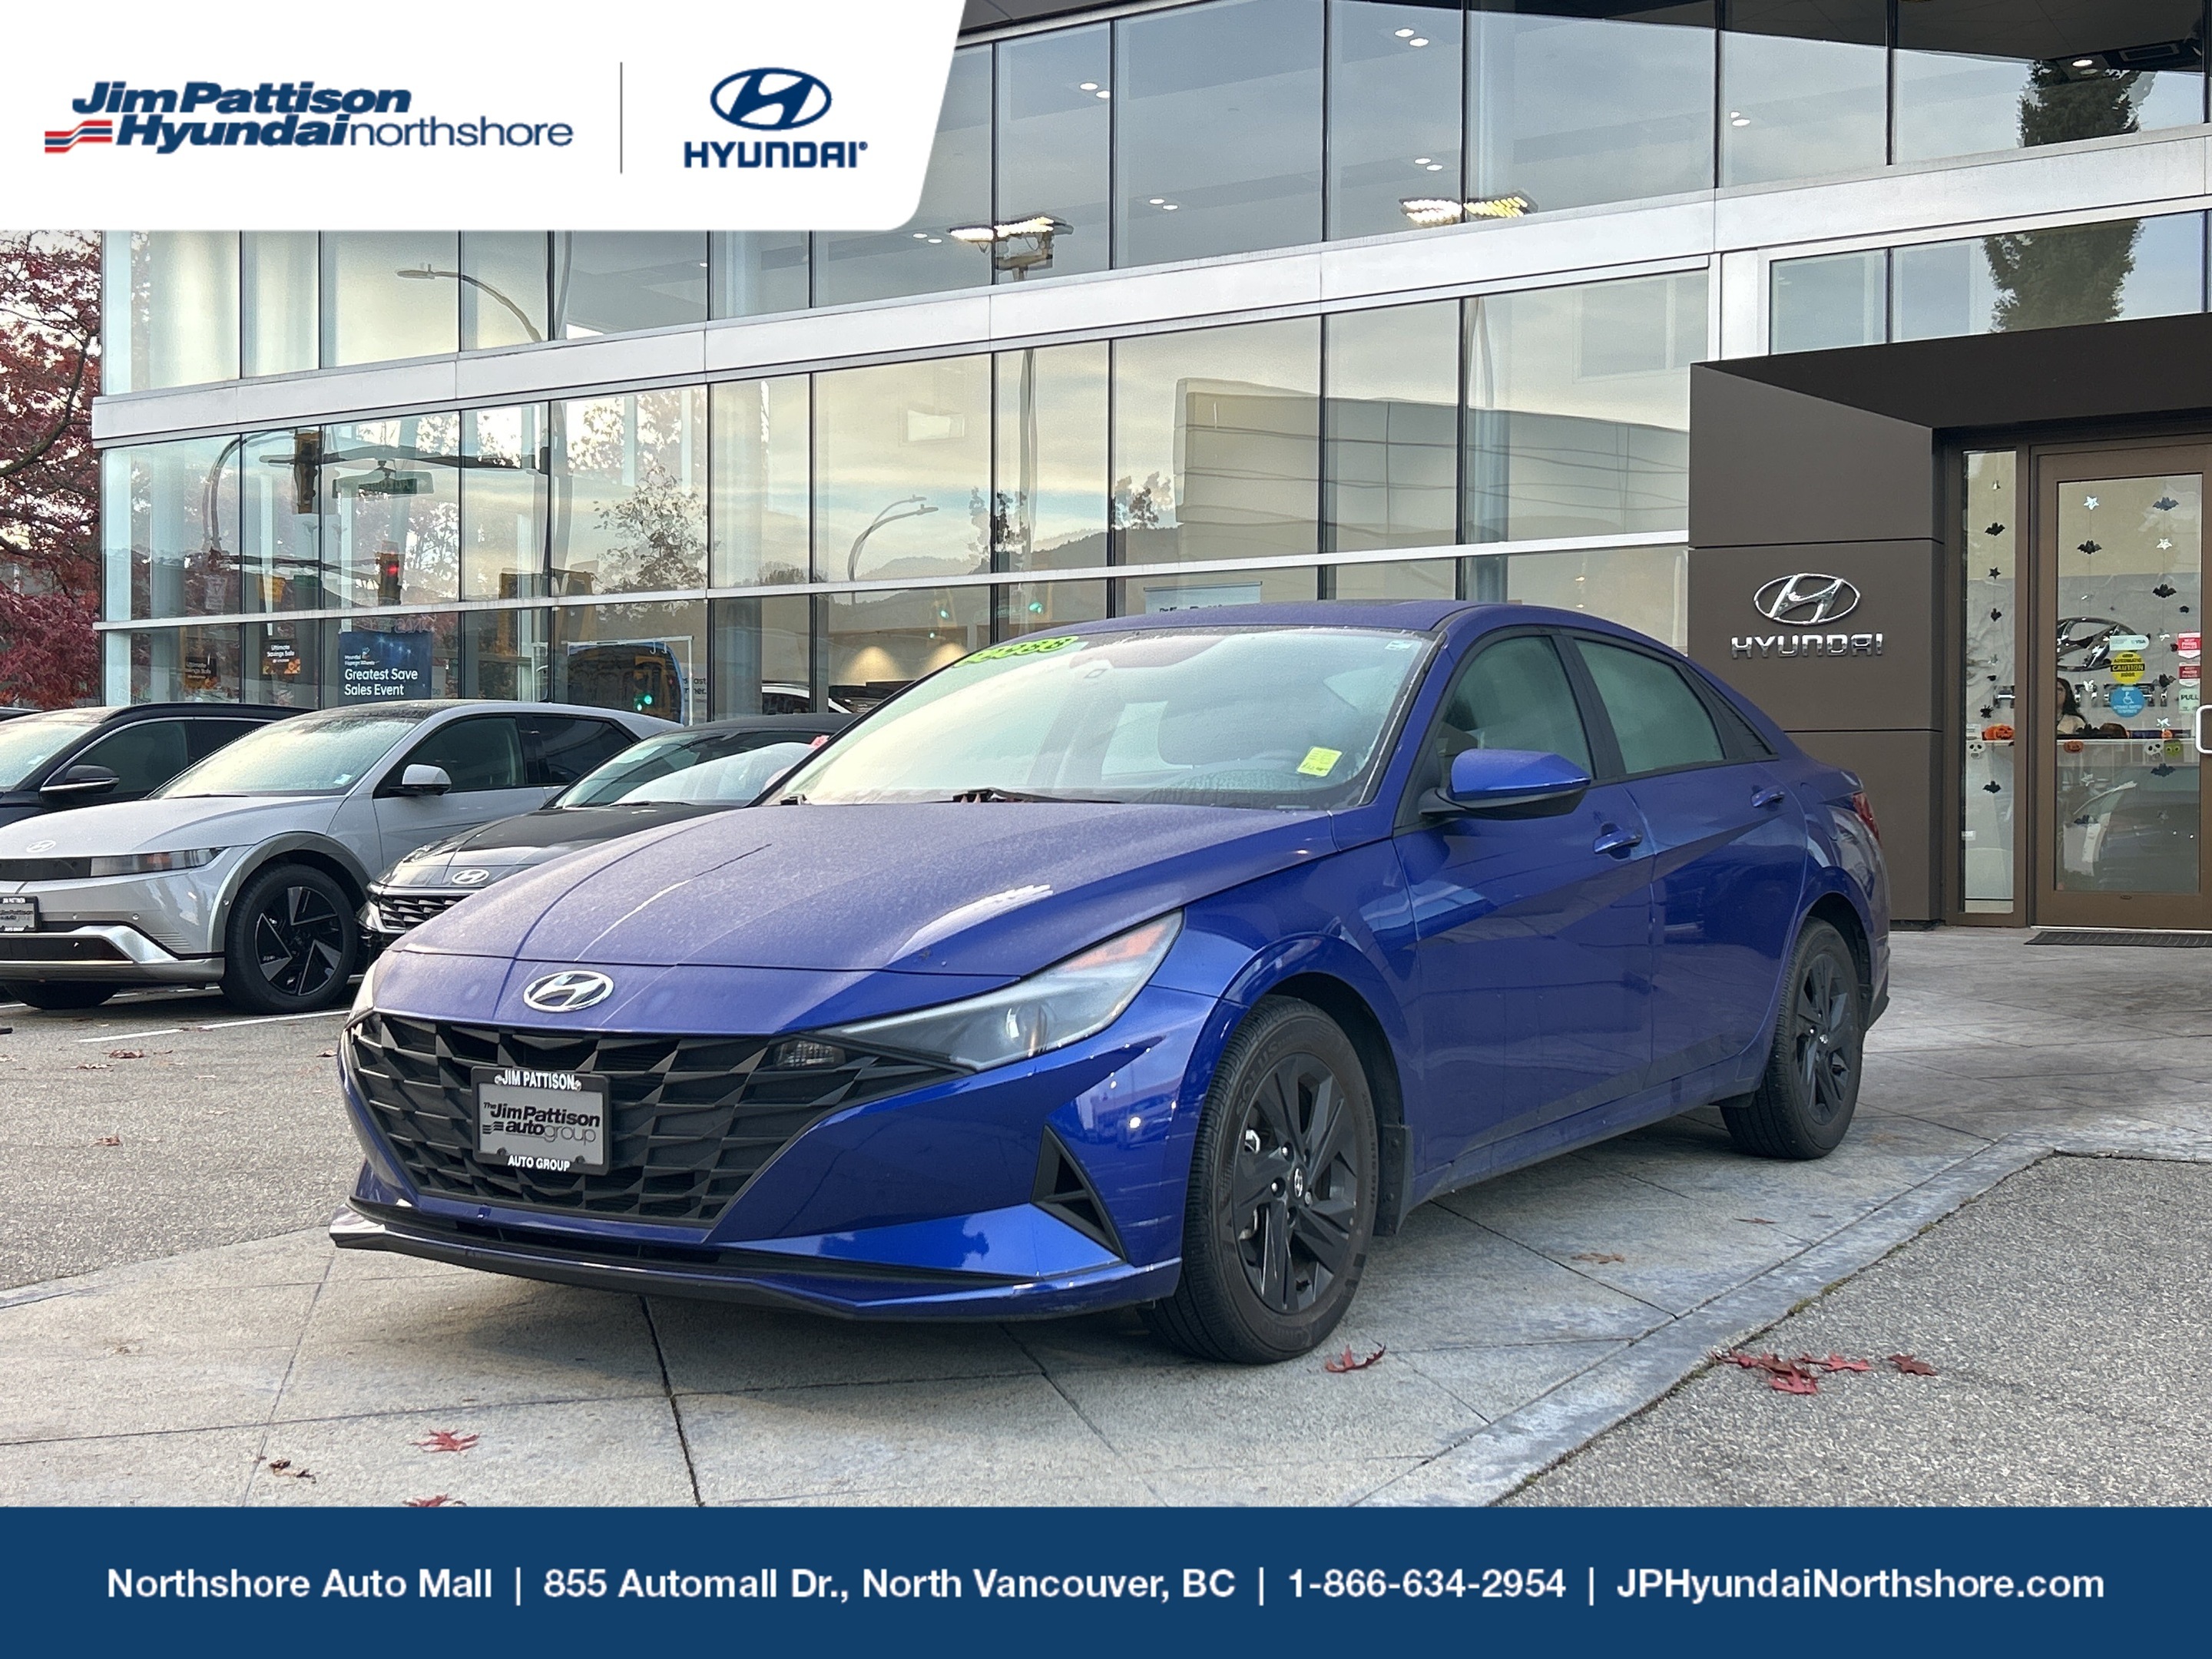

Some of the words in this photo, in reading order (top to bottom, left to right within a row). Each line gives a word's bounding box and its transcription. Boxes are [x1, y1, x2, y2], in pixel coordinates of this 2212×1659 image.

[1731, 633, 1883, 659] HYUNDAI
[344, 668, 389, 680] Greatest
[391, 667, 419, 680] Save
[344, 683, 373, 695] Sales
[374, 684, 405, 695] Event
[501, 1070, 521, 1086] JIM
[523, 1072, 576, 1091] PATTISON
[483, 1101, 498, 1110] The
[508, 1154, 534, 1168] AUTO
[535, 1158, 571, 1172] GROUP
